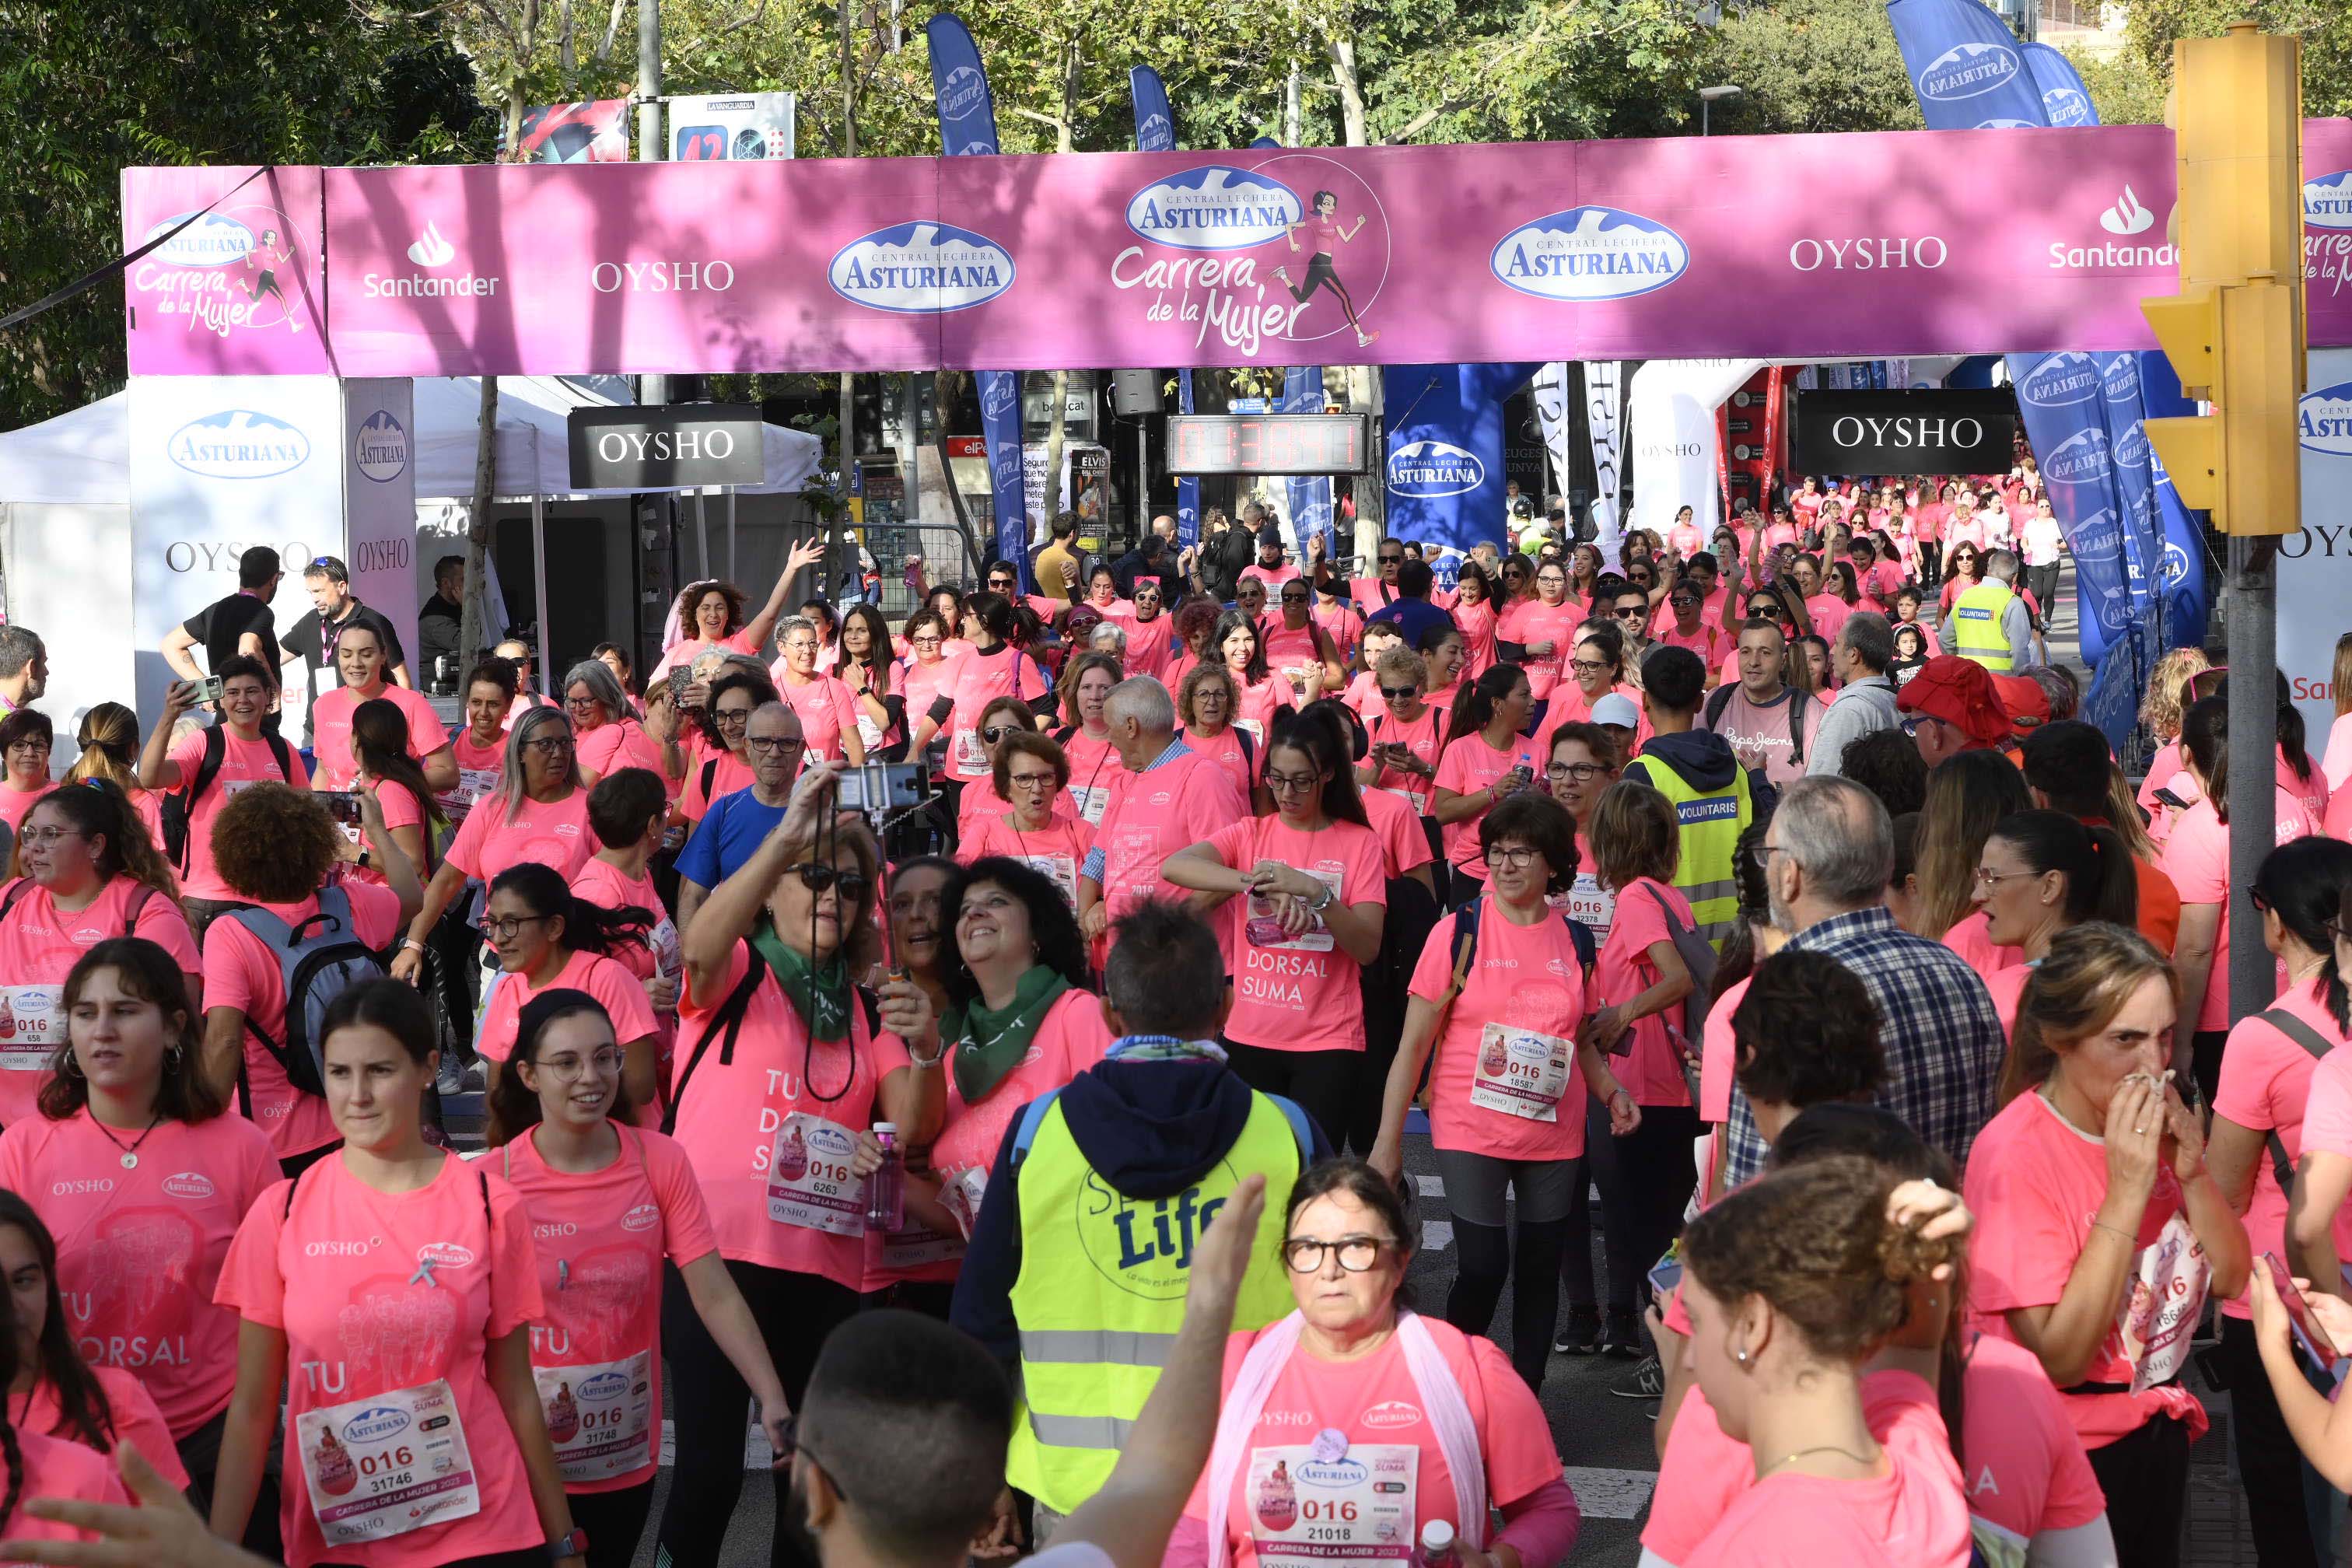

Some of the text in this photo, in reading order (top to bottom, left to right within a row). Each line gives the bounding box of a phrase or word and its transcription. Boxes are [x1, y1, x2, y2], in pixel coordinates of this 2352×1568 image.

[1167, 195, 1221, 204] CENTRAL
[1140, 198, 1290, 229] ASTURIANA
[1537, 237, 1668, 249] CENTRAL LECHERA
[871, 252, 996, 261] CENTRAL LECHERA
[1507, 243, 1674, 277] ASTURIANA
[1790, 236, 1948, 271] OYSHO
[591, 261, 734, 292] OYSHO
[843, 255, 1001, 291] ASTURIANA
[1111, 246, 1256, 290] Carrera
[2322, 256, 2335, 278] la
[135, 263, 226, 294] Carrera
[363, 272, 499, 297] Santander
[158, 289, 261, 337] de la Mujer
[1147, 285, 1311, 356] de la Mujer
[1832, 416, 1983, 448] OYSHO
[179, 436, 300, 461] ASTURIANA
[359, 436, 404, 464] ASTURIANA
[598, 429, 733, 463] OYSHO
[1642, 443, 1701, 457] OYSHO
[1082, 457, 1106, 467] ELVIS
[1024, 471, 1036, 479] que
[1389, 464, 1477, 485] ASTURIANA
[358, 538, 408, 572] OYSHO
[1532, 667, 1556, 675] SUMA
[1725, 727, 1754, 750] Pepe
[1475, 768, 1500, 777] OYSHO
[1678, 802, 1736, 819] VOLUNTARIS
[1573, 901, 1601, 912] 016
[1246, 949, 1328, 978] DORSAL
[1482, 958, 1518, 969] OYSHO
[1242, 976, 1303, 1003] SUMA
[18, 1019, 47, 1031] 016
[1513, 1042, 1546, 1056] ASTURIANA
[1510, 1062, 1541, 1079] 016
[766, 1069, 800, 1101] TU
[1484, 1083, 1510, 1094] CARRERA
[1510, 1078, 1534, 1090] 18587
[1479, 1093, 1507, 1106] OYSHO
[810, 1135, 852, 1153] ASTURIANA
[810, 1160, 848, 1182] 016
[53, 1179, 113, 1195] OYSHO
[166, 1182, 212, 1194] ASTURIANA
[779, 1189, 810, 1202] CARRERA
[814, 1181, 838, 1195] 6263
[773, 1204, 807, 1219] OYSHO
[306, 1241, 368, 1257] OYSHO
[530, 1326, 569, 1355] TU
[78, 1336, 190, 1366] ORSAL
[300, 1361, 346, 1394] TU
[414, 1399, 445, 1412] SUMA
[583, 1408, 622, 1429] 016
[1367, 1411, 1419, 1423] ASTURIANA
[349, 1418, 406, 1439] ASTURIANA
[586, 1430, 617, 1444] 31748
[360, 1446, 413, 1475] 016
[588, 1448, 597, 1457] DE
[599, 1445, 608, 1454] LA
[371, 1472, 413, 1492] 31746
[1302, 1468, 1362, 1479] ASTURIANA
[335, 1499, 378, 1517] CARRERA
[379, 1495, 392, 1504] DE
[394, 1492, 405, 1501] LA
[406, 1485, 438, 1499] MUJER
[421, 1495, 468, 1517] Santander
[1303, 1500, 1358, 1521] 016
[338, 1517, 385, 1537] OYSHO
[1308, 1528, 1351, 1540] 21018
[1267, 1545, 1311, 1554] CARRERA
[1311, 1547, 1325, 1556] DE
[1327, 1547, 1340, 1556] LA
[1341, 1548, 1374, 1556] MUJER
